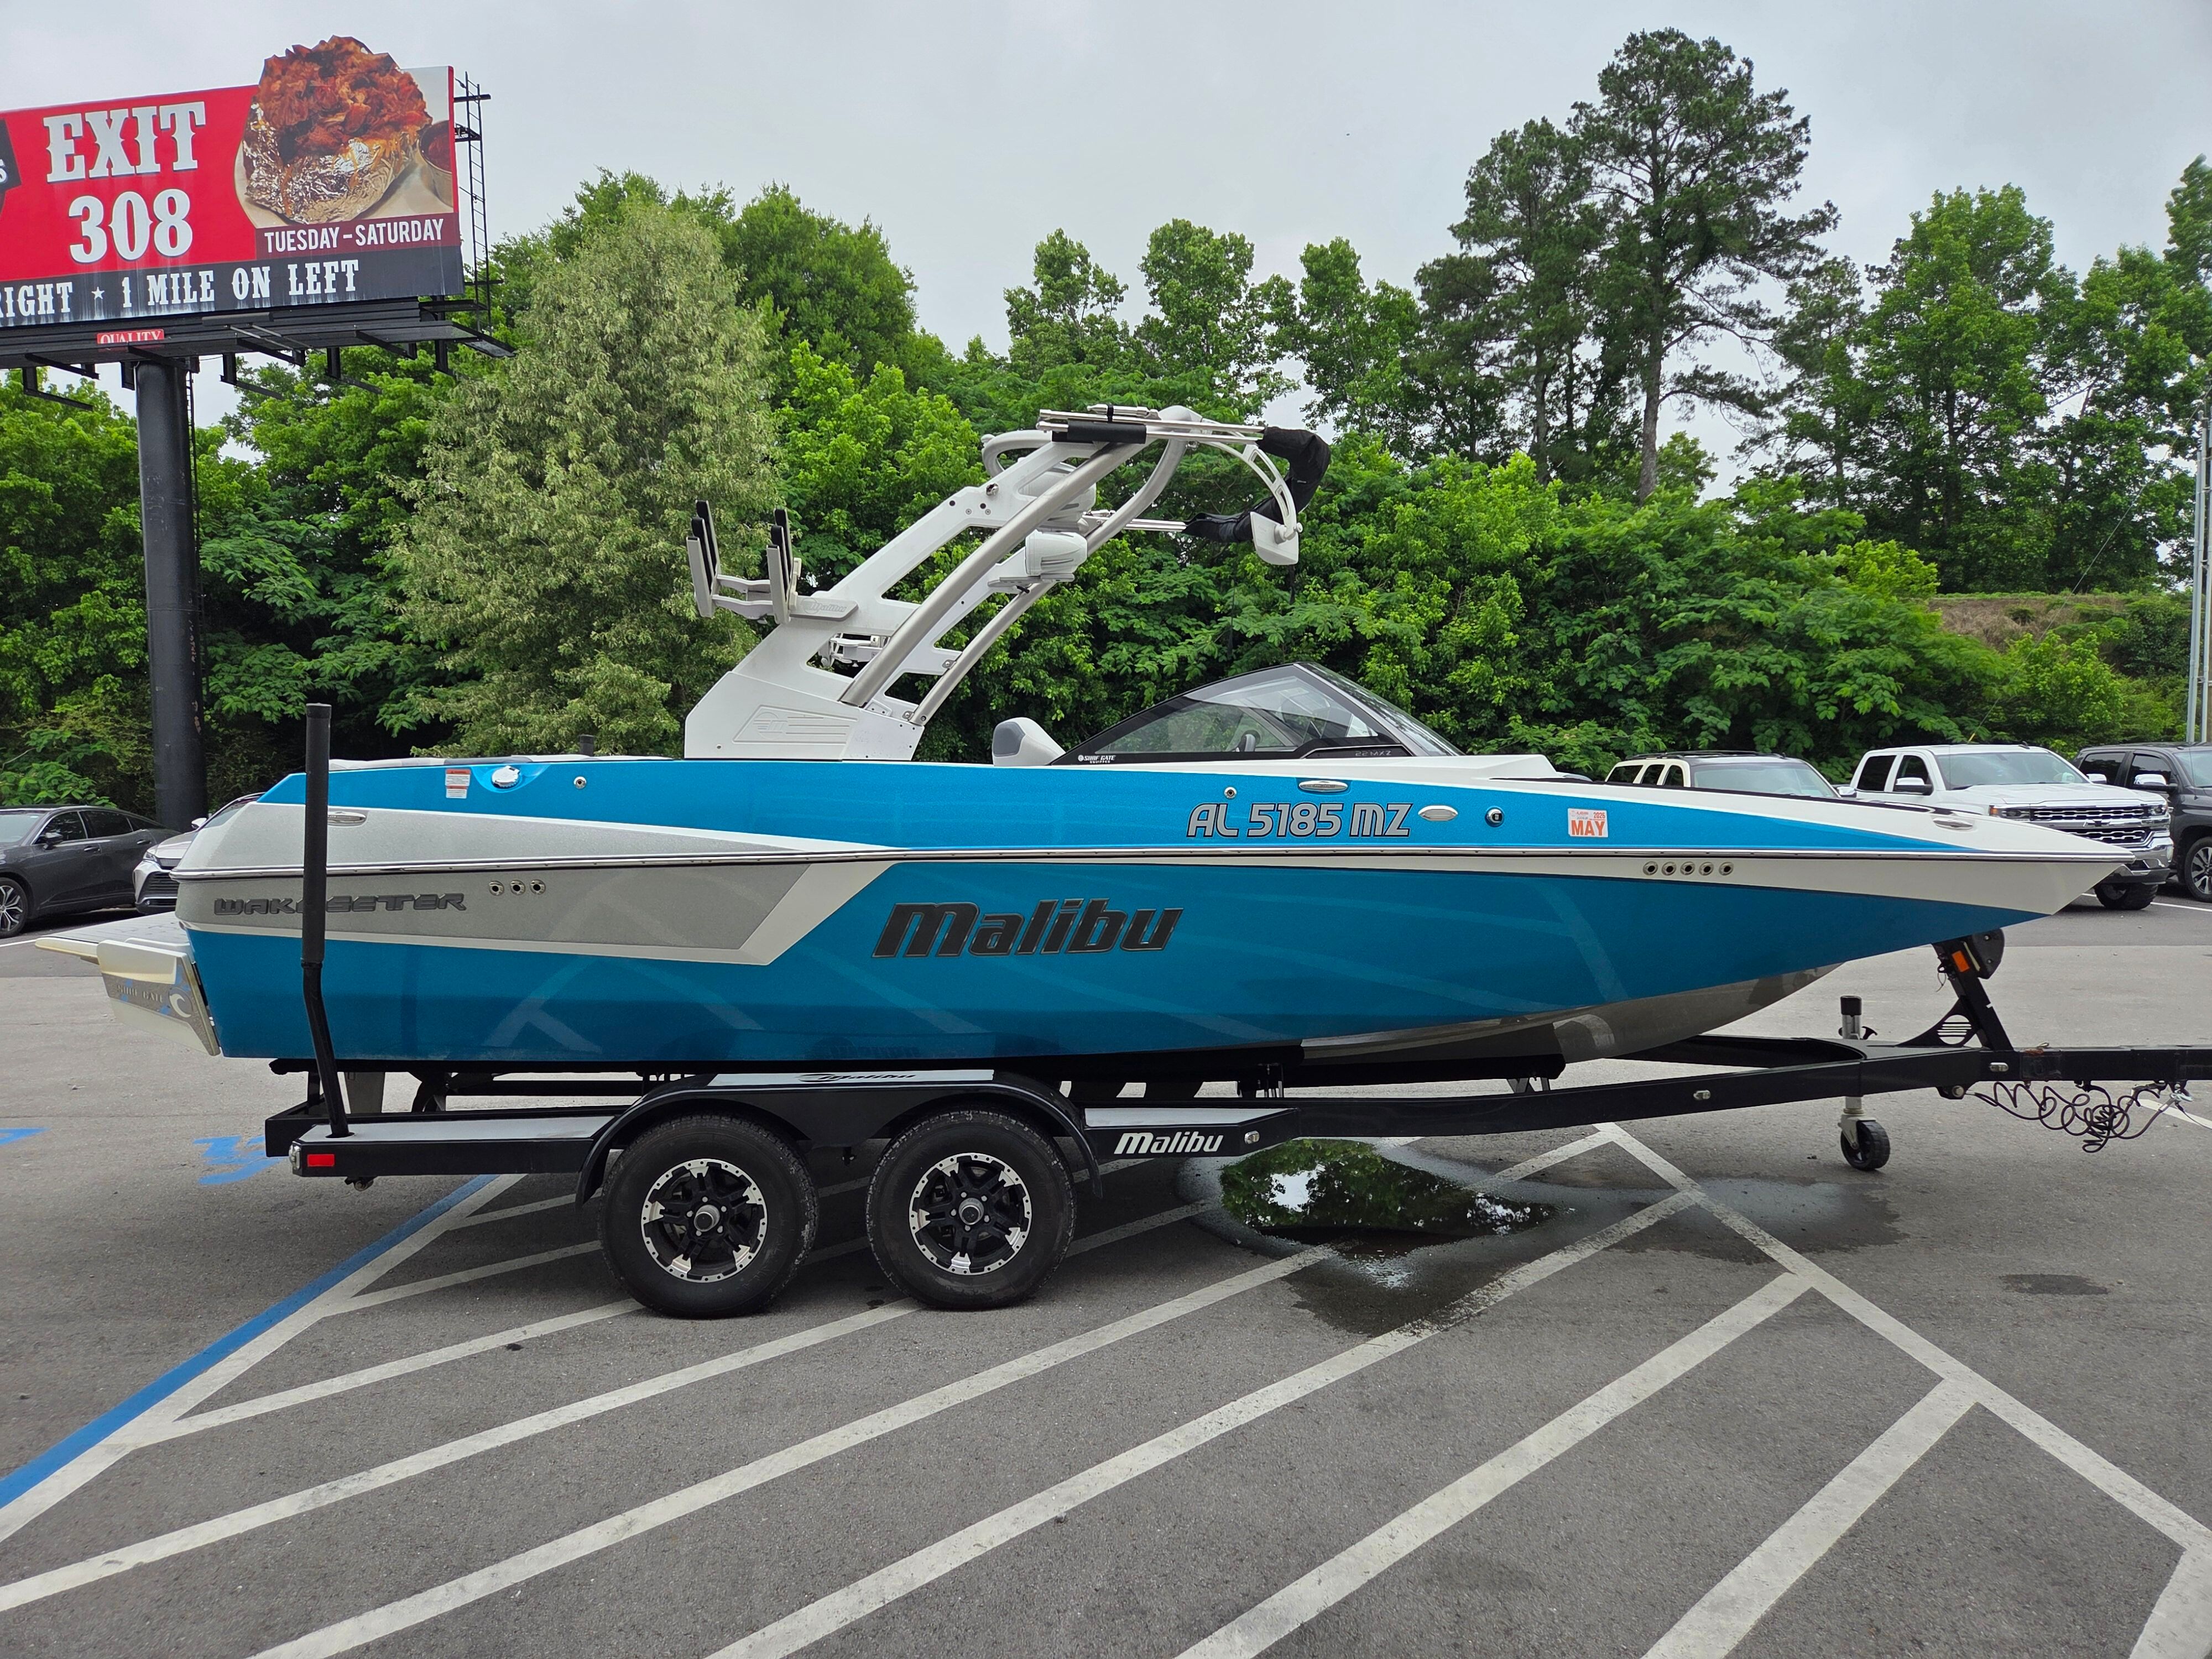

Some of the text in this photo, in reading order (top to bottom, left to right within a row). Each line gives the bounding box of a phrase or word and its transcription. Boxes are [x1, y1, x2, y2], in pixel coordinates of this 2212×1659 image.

[43, 102, 206, 183] EXIT
[69, 188, 193, 263] 308
[122, 276, 132, 307] 1
[147, 270, 215, 306] MILE
[232, 266, 271, 299] ON
[288, 259, 359, 295] LEFT
[100, 330, 161, 344] QUALITY
[1186, 802, 1413, 838] AL 5185 MZ
[1572, 820, 1605, 836] MAY
[871, 898, 1185, 958] Malibu
[1114, 1132, 1224, 1155] Malibu
